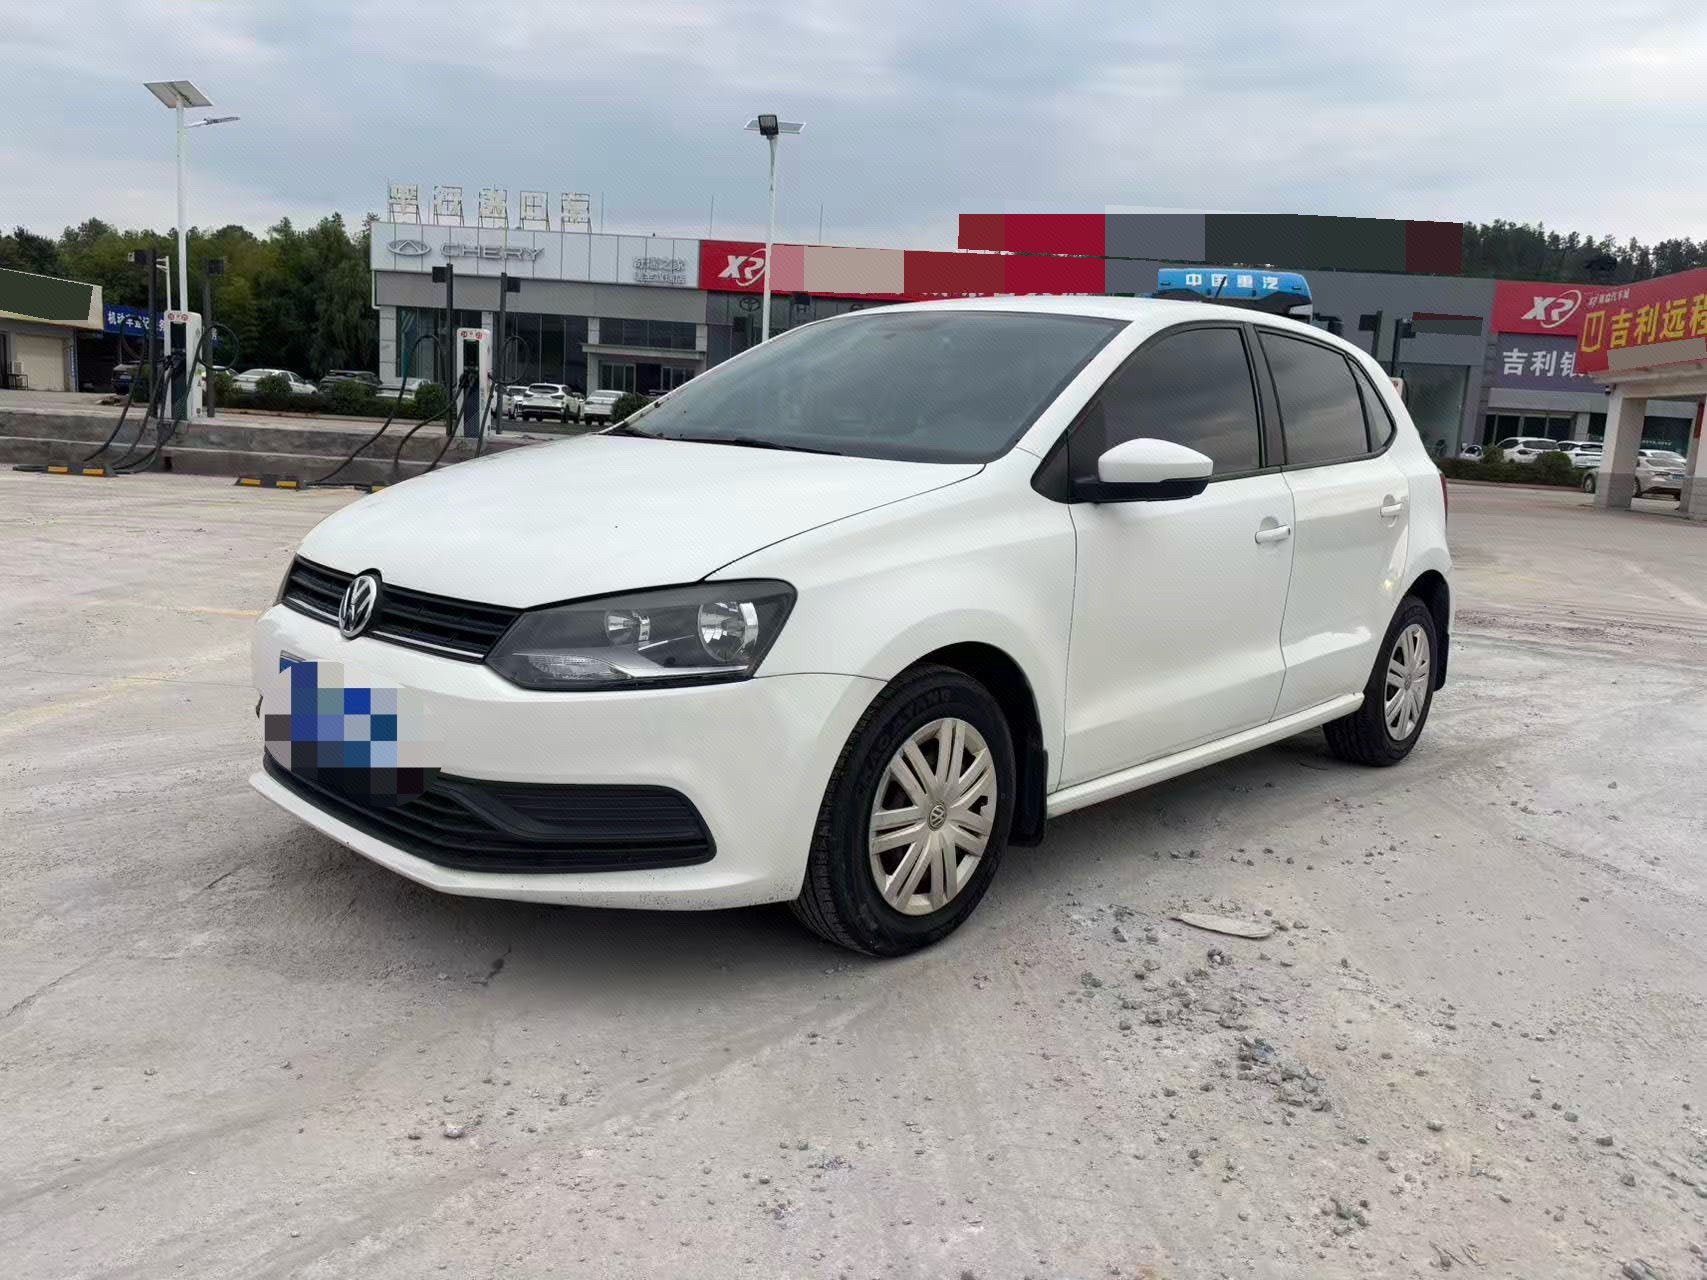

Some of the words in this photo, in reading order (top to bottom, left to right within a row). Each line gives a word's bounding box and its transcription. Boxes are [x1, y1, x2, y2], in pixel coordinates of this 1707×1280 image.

[440, 242, 545, 262] CHERY
[1185, 272, 1280, 290] 中国重汽
